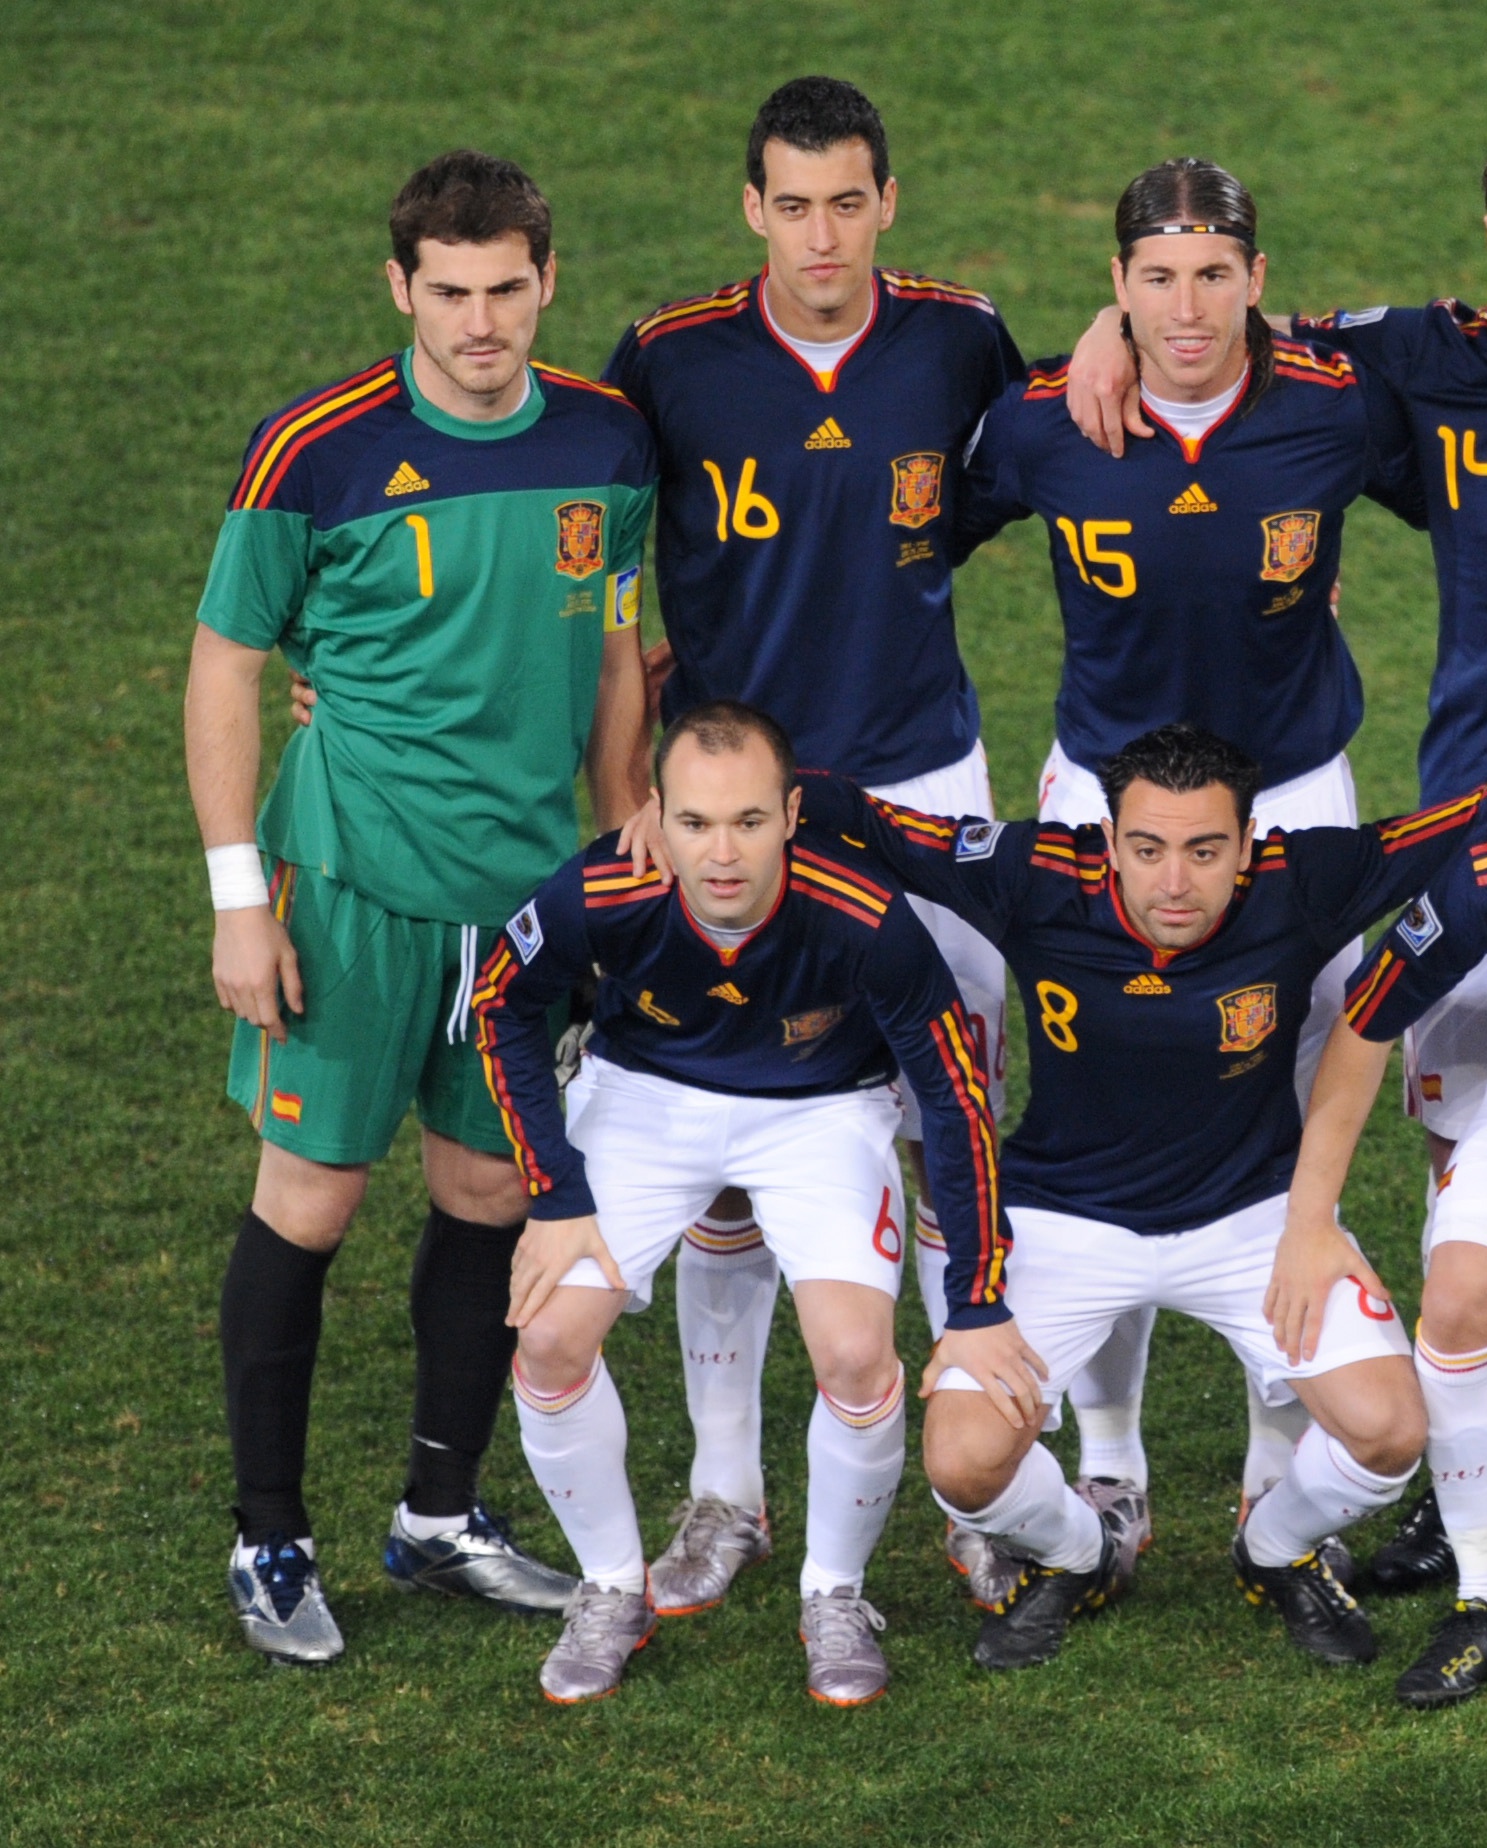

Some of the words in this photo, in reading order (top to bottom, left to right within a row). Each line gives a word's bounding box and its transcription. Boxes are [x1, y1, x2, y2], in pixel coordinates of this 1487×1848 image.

[804, 438, 852, 450] adidas
[384, 479, 430, 497] adidas
[702, 457, 780, 542] 16
[1168, 502, 1218, 514] adidas
[406, 514, 434, 598] 1
[1056, 517, 1137, 598] 15
[1036, 980, 1079, 1053] 8
[1122, 984, 1172, 995] adidas
[872, 1186, 903, 1263] 6
